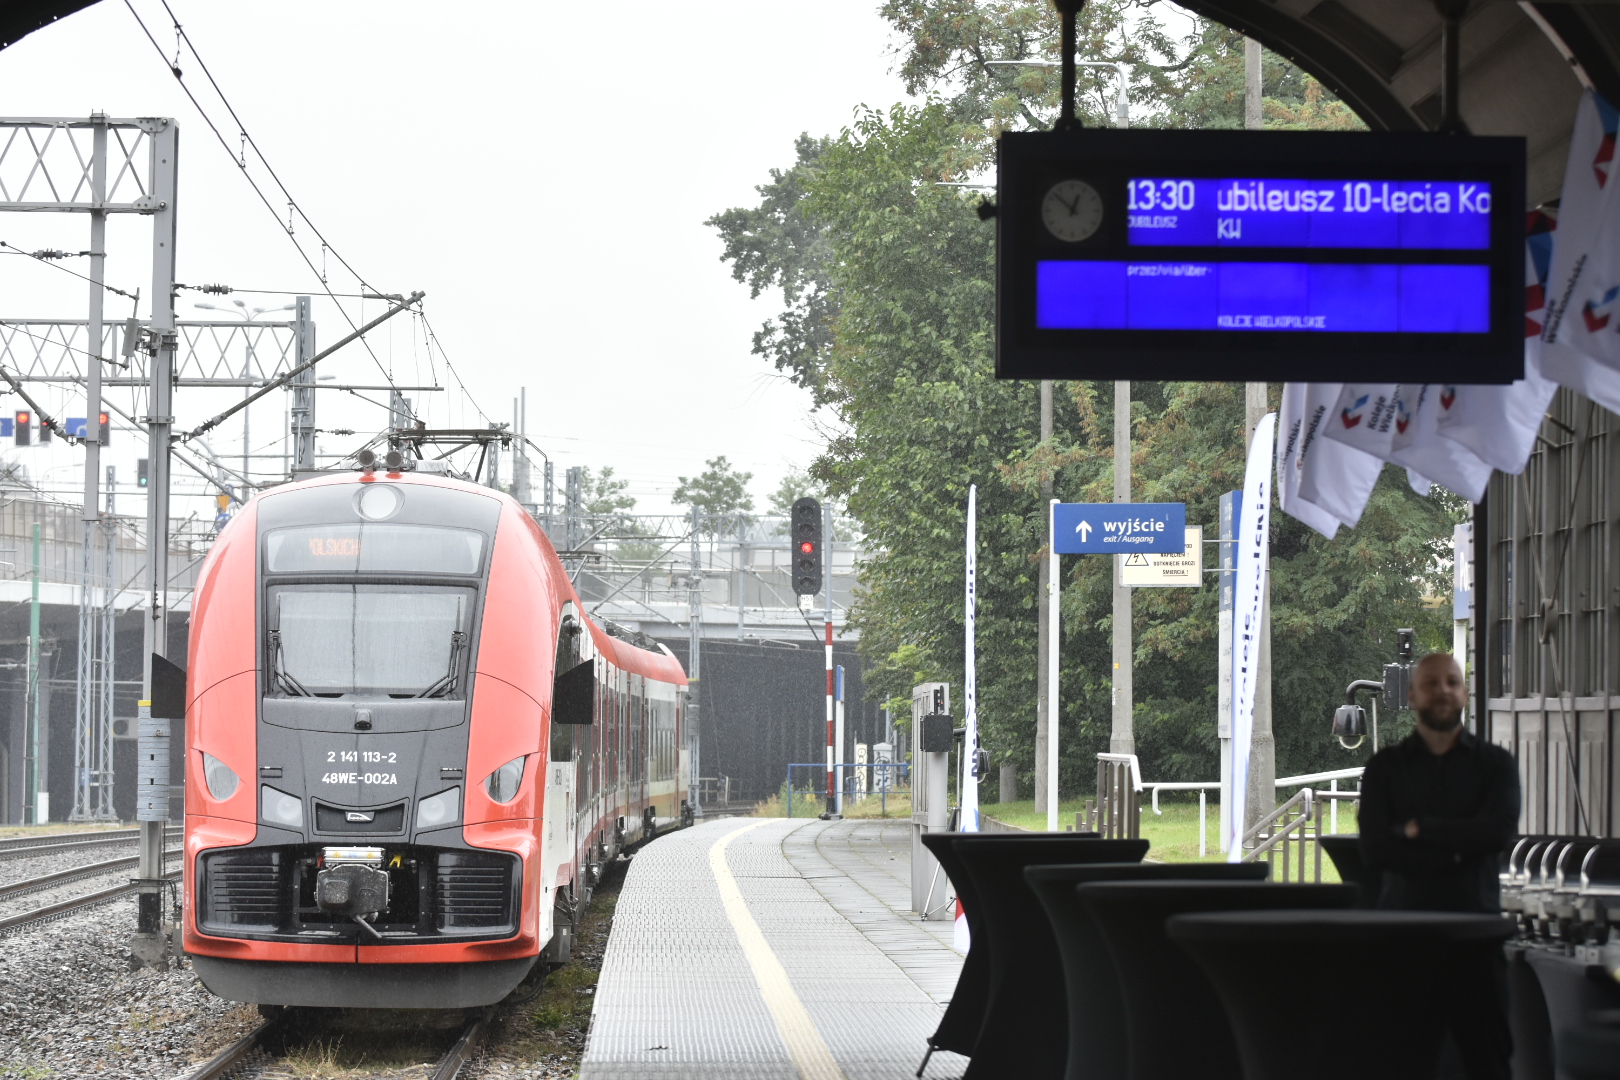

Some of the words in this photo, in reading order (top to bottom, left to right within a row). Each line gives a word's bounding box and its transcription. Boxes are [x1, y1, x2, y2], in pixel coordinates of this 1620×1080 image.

[1127, 179, 1195, 211] 13:30
[1217, 181, 1335, 213] ubileusz
[1342, 182, 1451, 214] 10-lecia
[1458, 183, 1492, 214] Ko
[1217, 217, 1241, 239] KW
[1366, 395, 1387, 430] Koleje
[1103, 518, 1165, 535] wyjście
[1103, 535, 1117, 543] exit
[1121, 535, 1155, 544] Ausgang
[327, 751, 336, 763] 2
[340, 751, 358, 762] 141
[362, 751, 397, 763] 113-2
[322, 772, 398, 785] 48WE-002A
